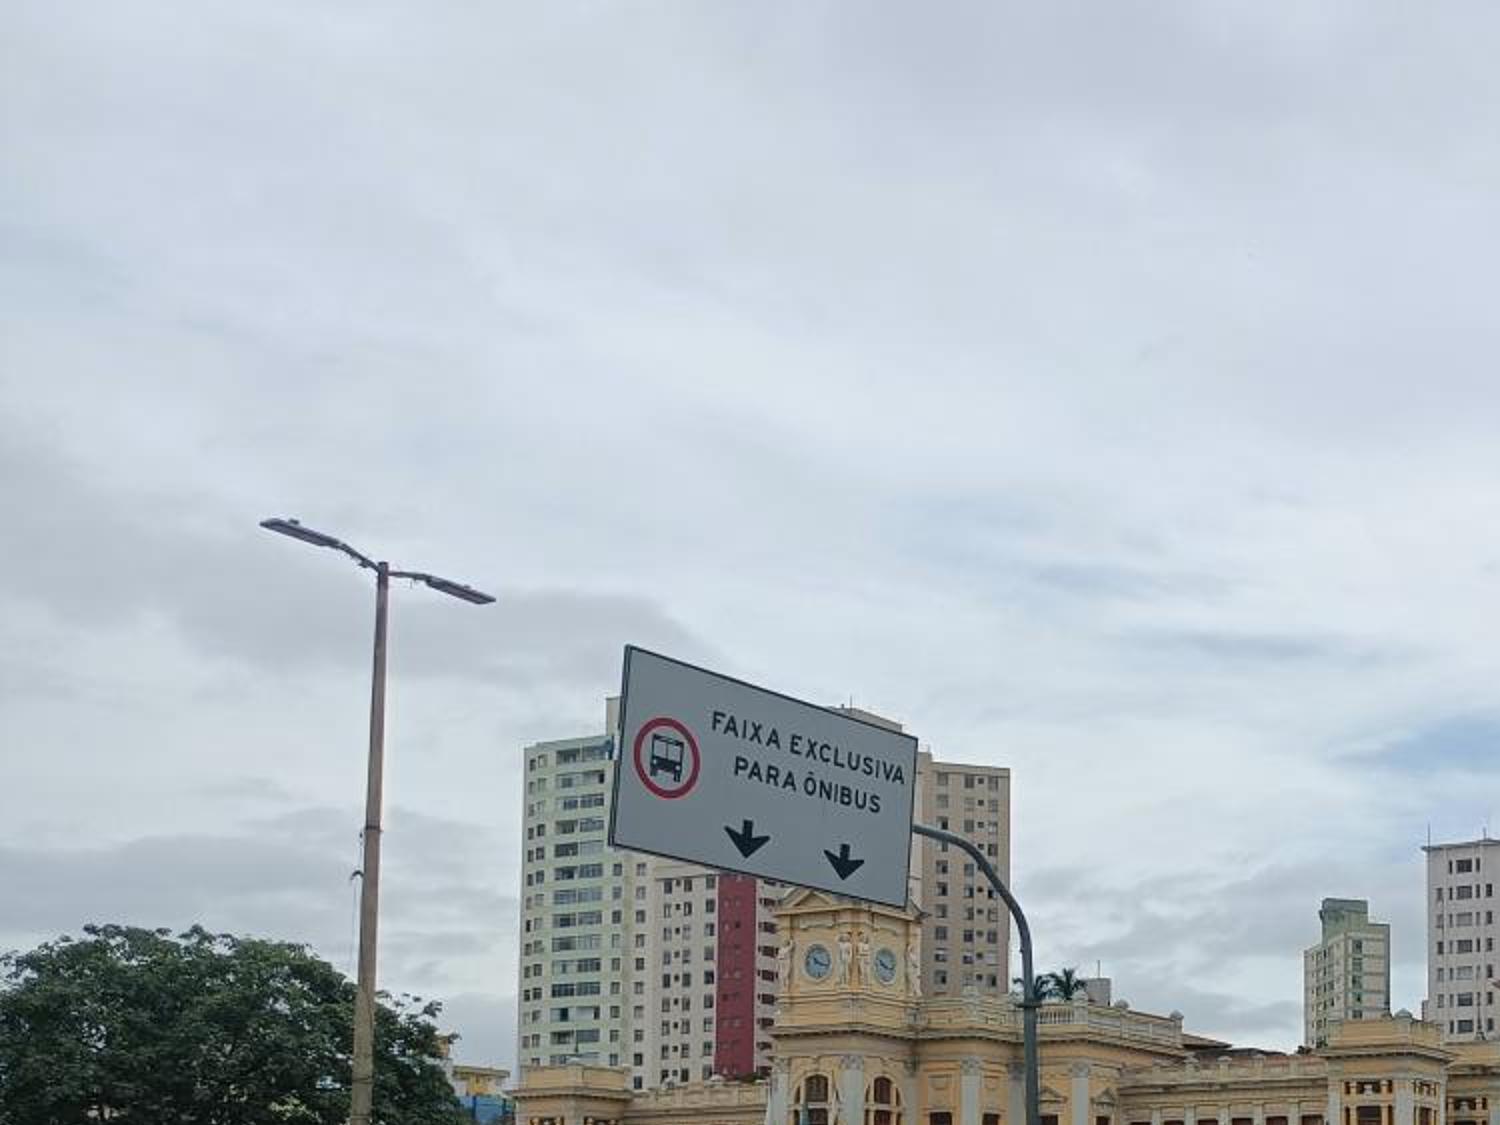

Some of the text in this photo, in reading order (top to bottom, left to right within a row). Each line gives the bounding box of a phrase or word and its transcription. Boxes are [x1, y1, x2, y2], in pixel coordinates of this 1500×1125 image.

[711, 711, 905, 785] FAIXA EXCLUSIVA
[734, 756, 881, 813] PARA ÔNIBUS
